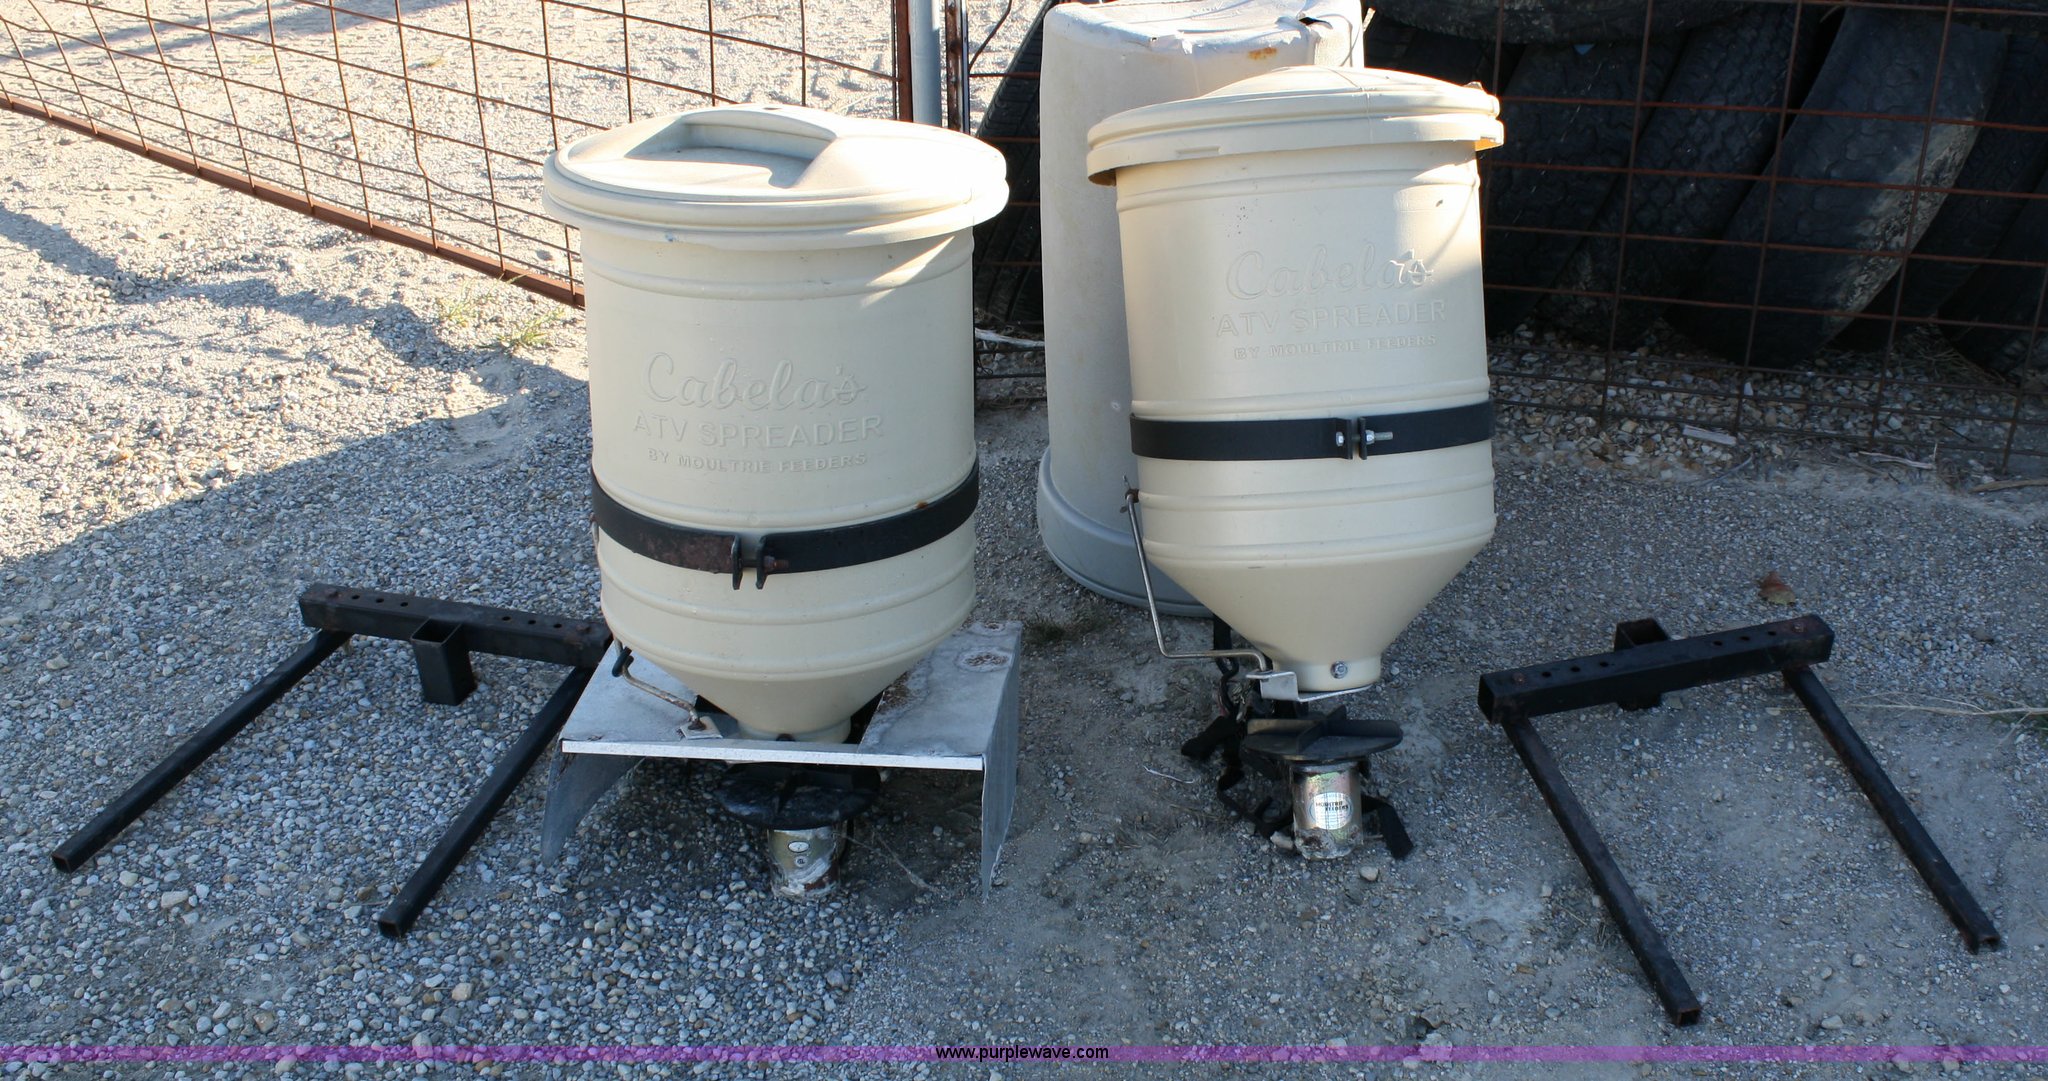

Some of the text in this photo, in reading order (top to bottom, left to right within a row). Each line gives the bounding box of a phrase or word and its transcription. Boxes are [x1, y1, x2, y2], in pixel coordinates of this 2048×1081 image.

[1226, 243, 1436, 300] Cabela's
[1216, 300, 1448, 337] ATV SPREADER
[1234, 334, 1437, 360] BY MOULTRIE FEEDERS
[640, 351, 868, 411] Cabela's
[633, 410, 884, 449] ATV SPREADER
[648, 448, 867, 473] BY MOULTRIE FEEDERS
